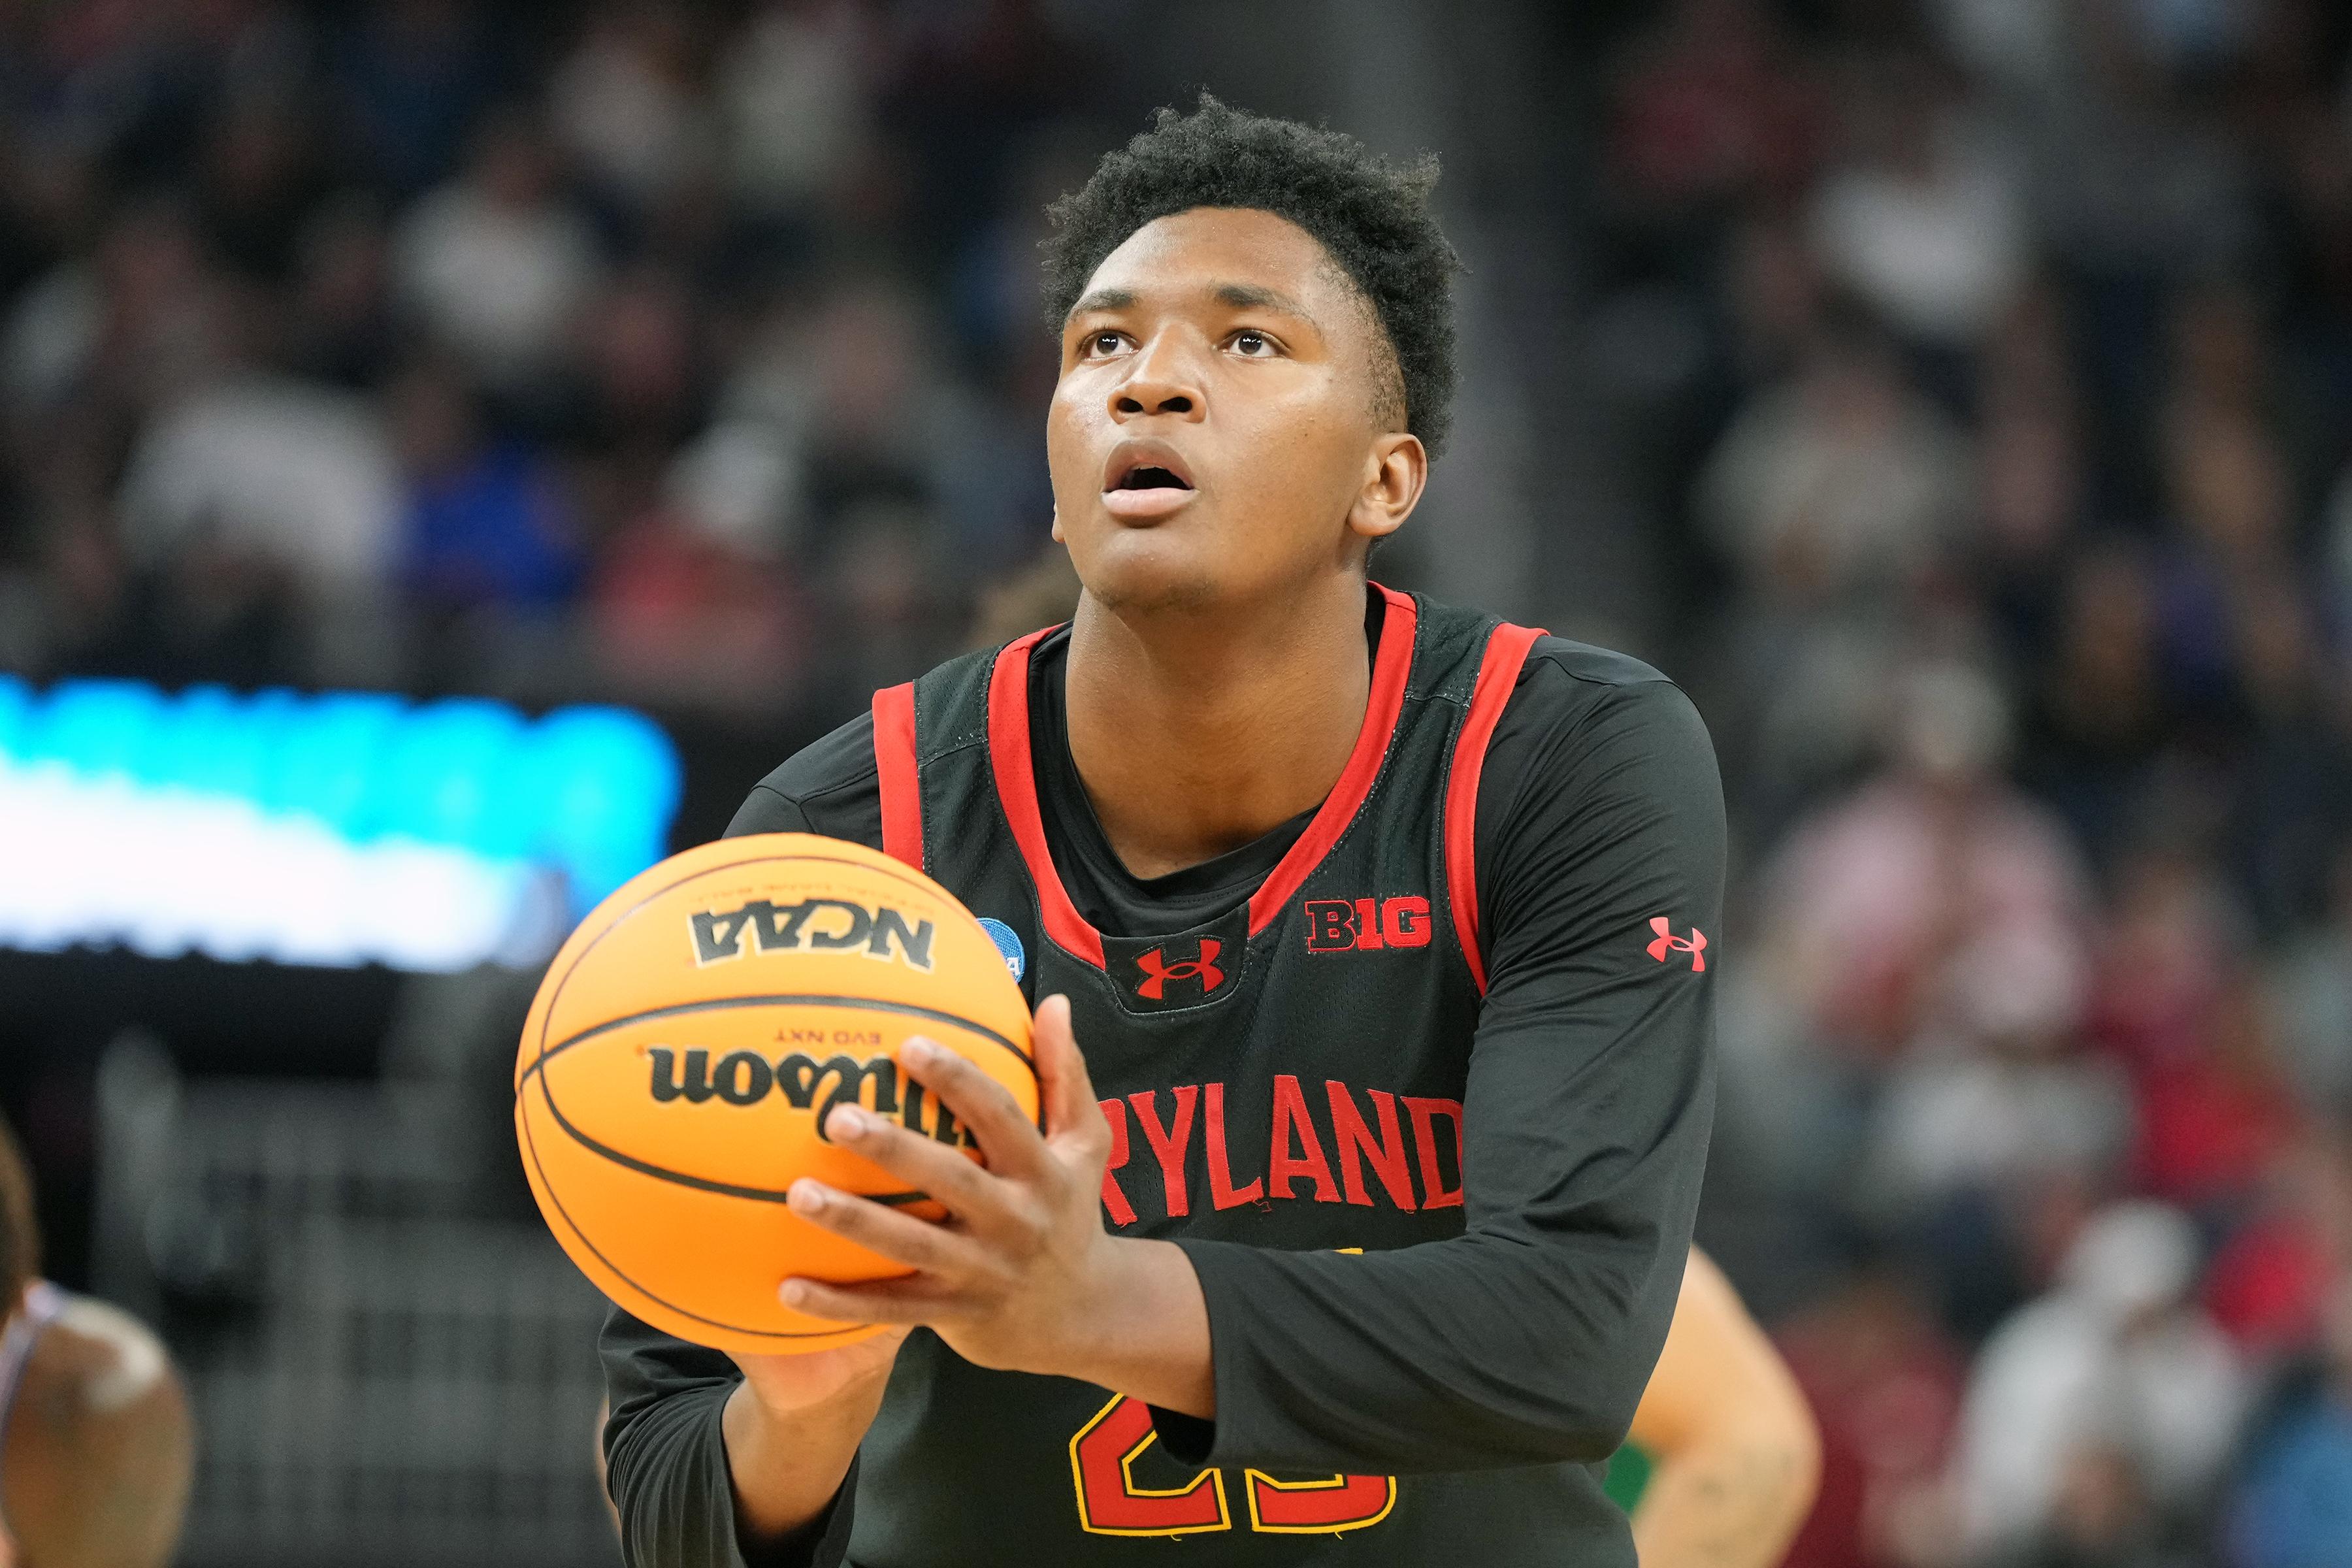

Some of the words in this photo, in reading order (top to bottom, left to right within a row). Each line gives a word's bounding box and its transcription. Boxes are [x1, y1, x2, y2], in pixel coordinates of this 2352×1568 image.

[683, 898, 935, 973] NCAA
[774, 1028, 825, 1043] NXT
[833, 1030, 882, 1045] EVO
